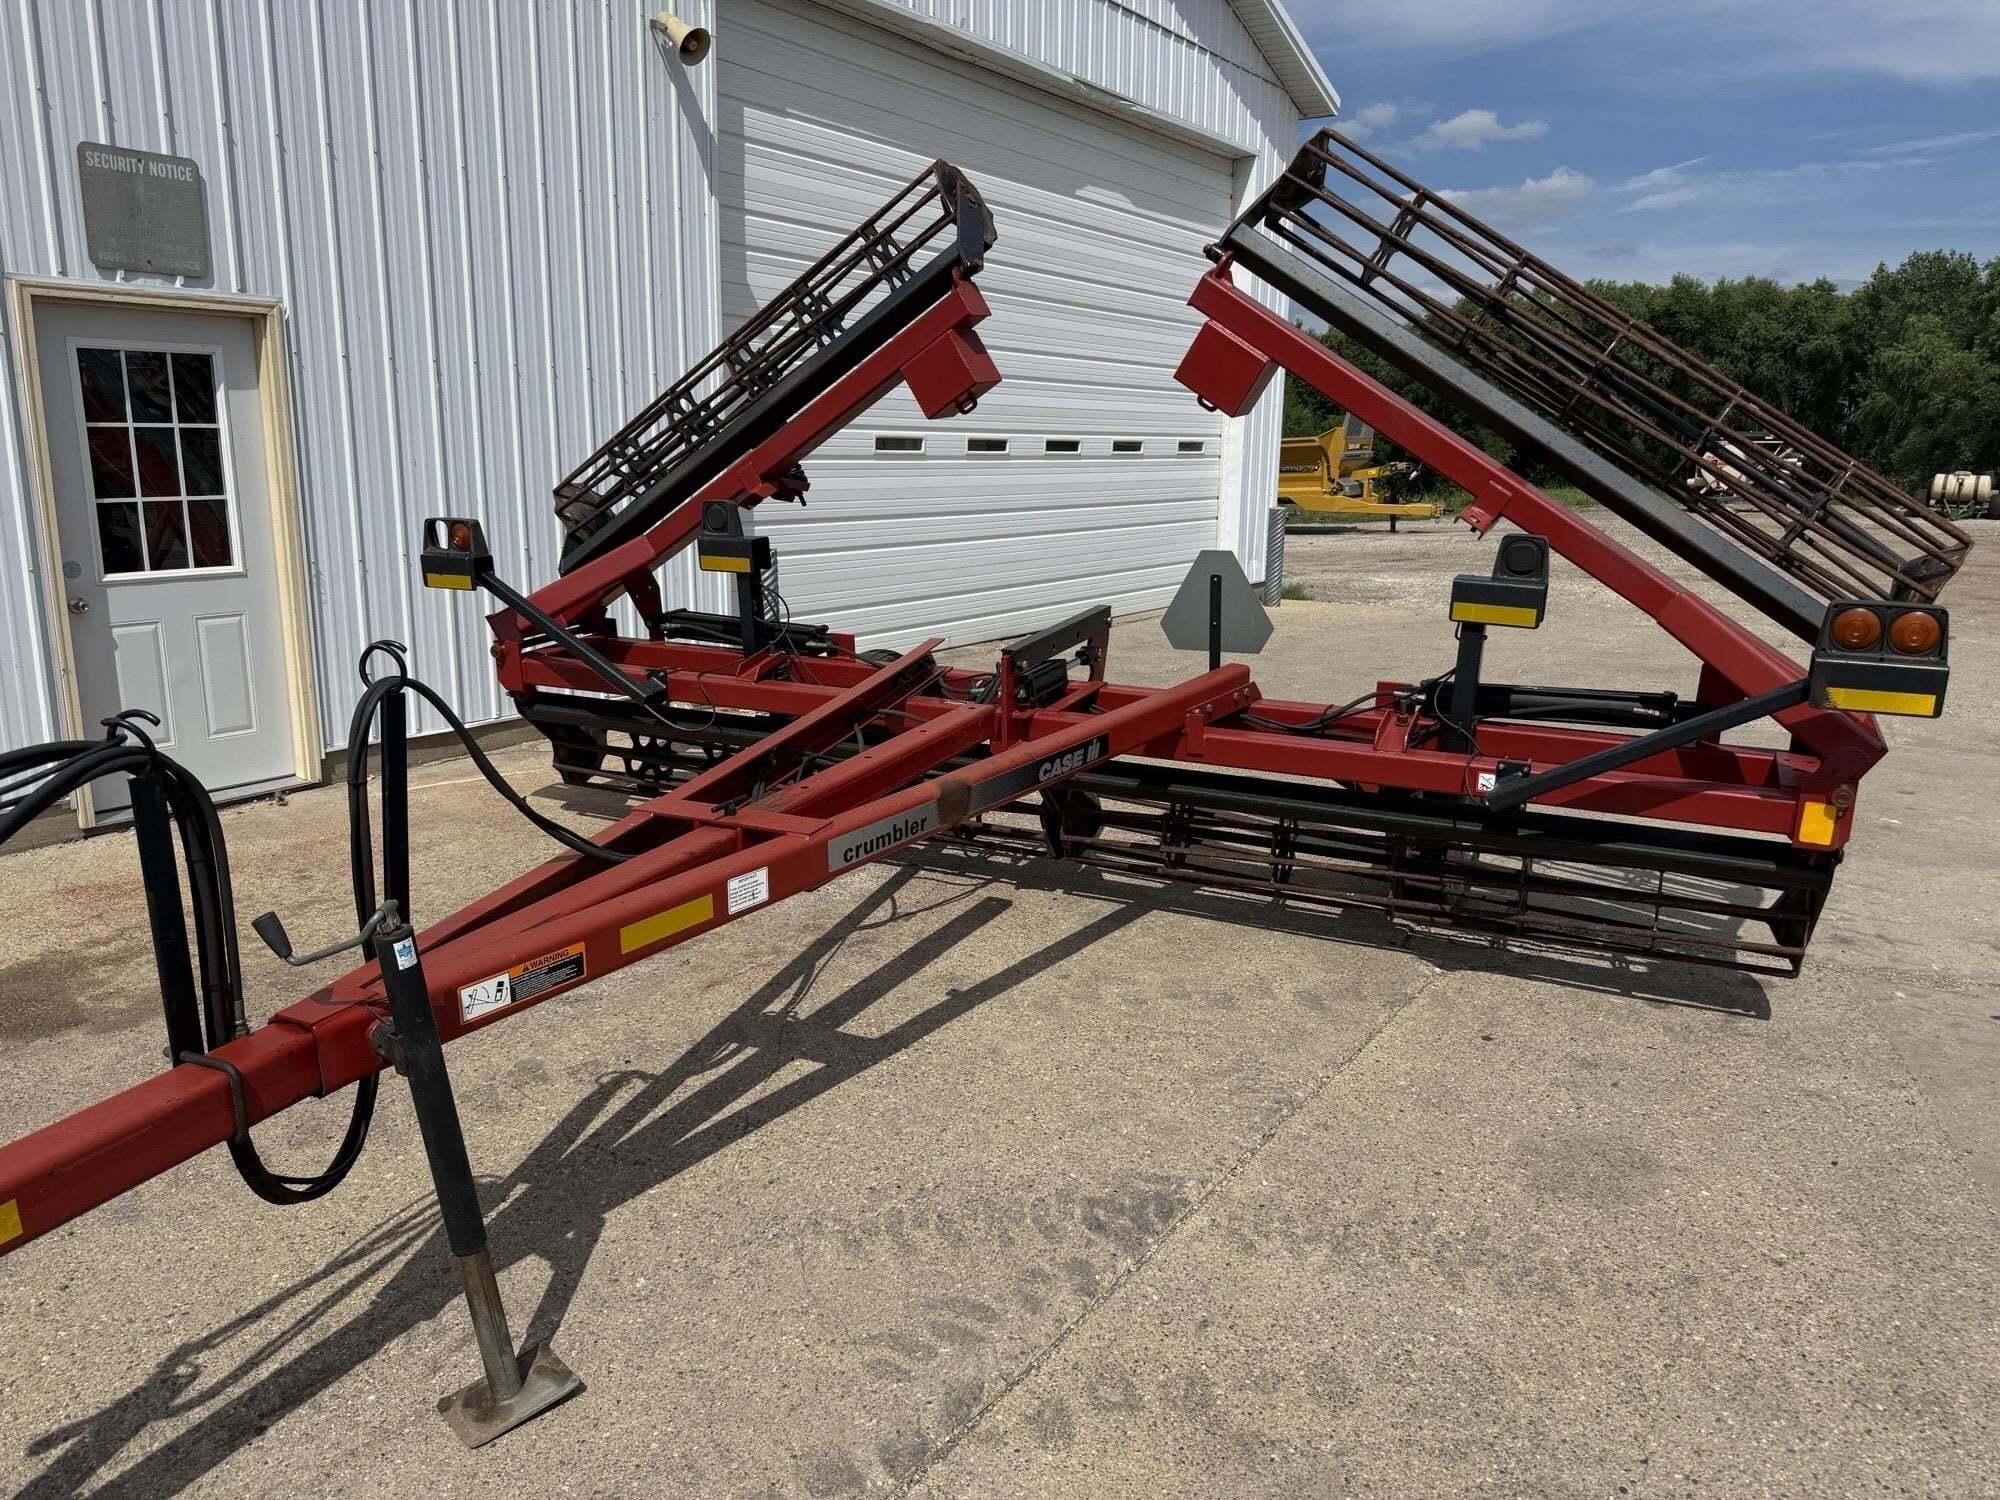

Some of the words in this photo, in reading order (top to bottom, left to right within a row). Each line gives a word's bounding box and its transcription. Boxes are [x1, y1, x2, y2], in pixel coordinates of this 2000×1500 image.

[85, 150, 145, 175] SECURITY
[149, 161, 193, 182] NOTICE
[1038, 750, 1084, 783] CASE
[843, 816, 928, 864] crumbler
[530, 948, 570, 970] WARNING
